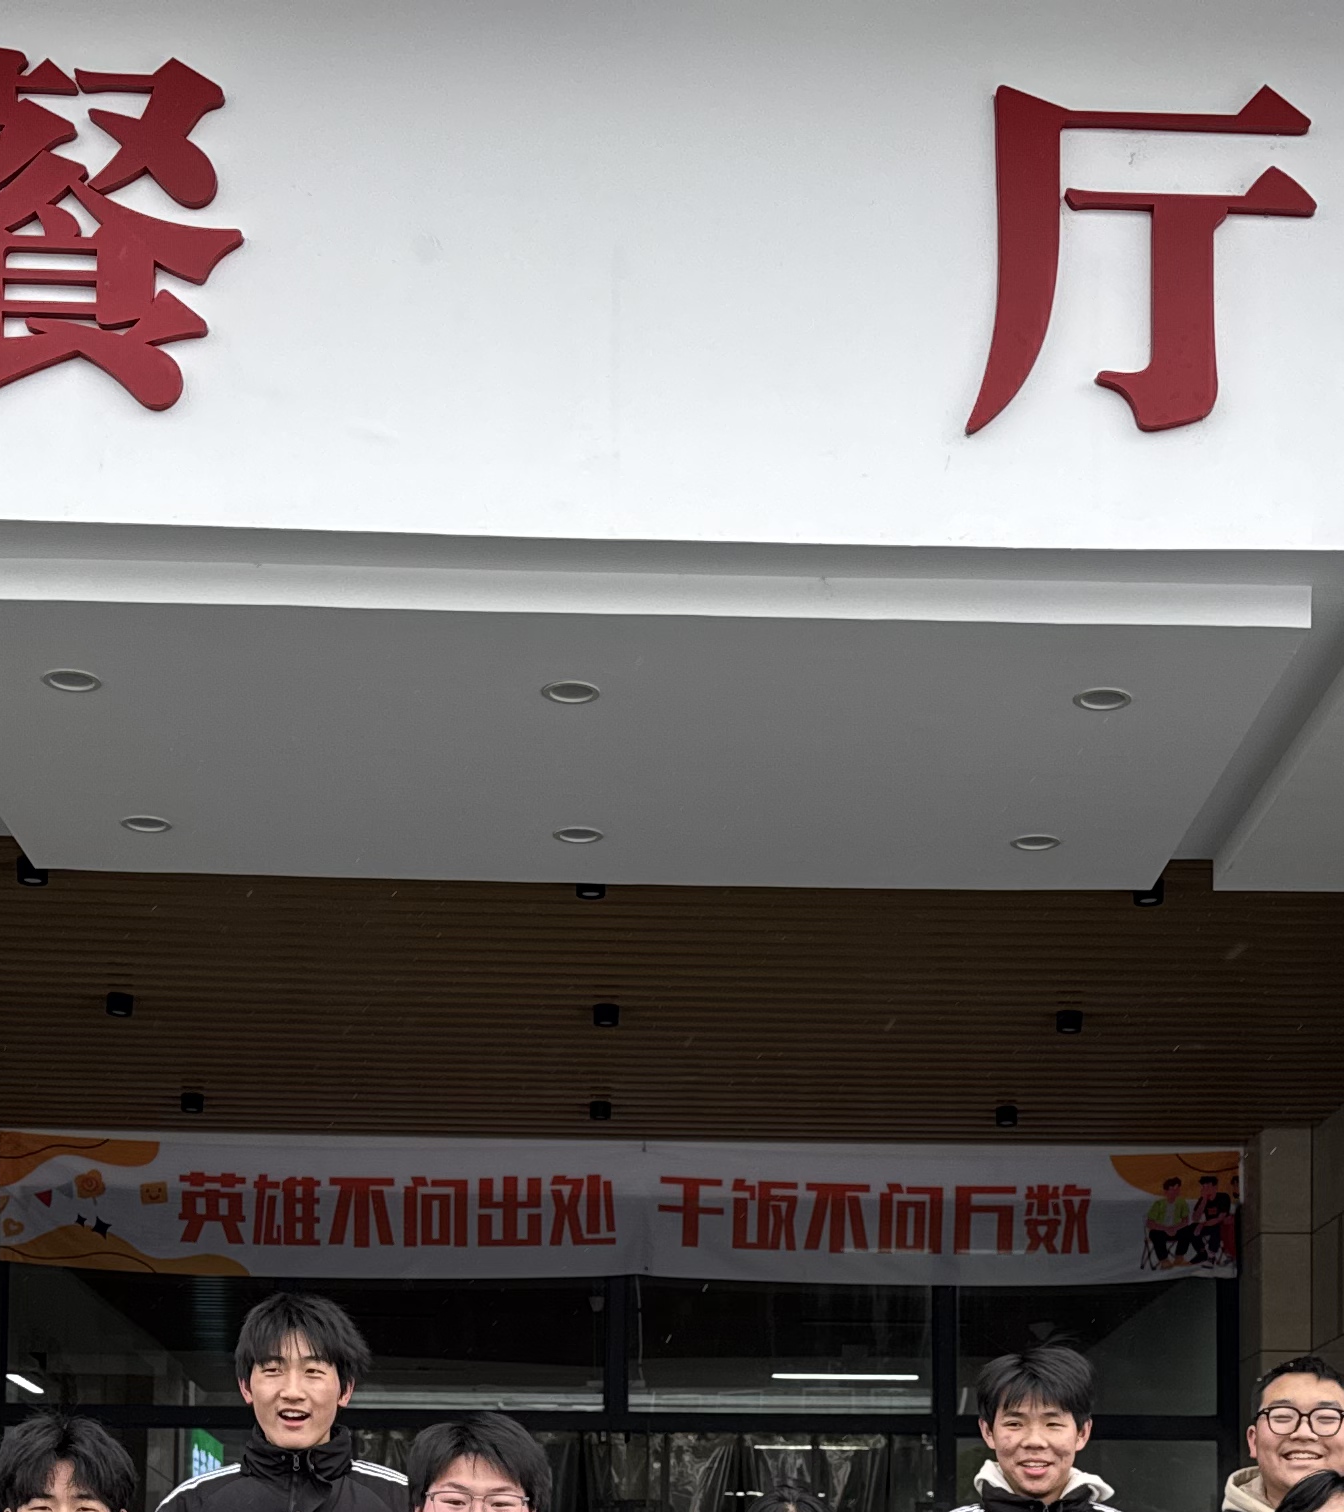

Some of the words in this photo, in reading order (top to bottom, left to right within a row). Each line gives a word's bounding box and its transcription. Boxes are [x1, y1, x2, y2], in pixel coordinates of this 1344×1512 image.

[179, 1171, 618, 1248] 英雄不问出处
